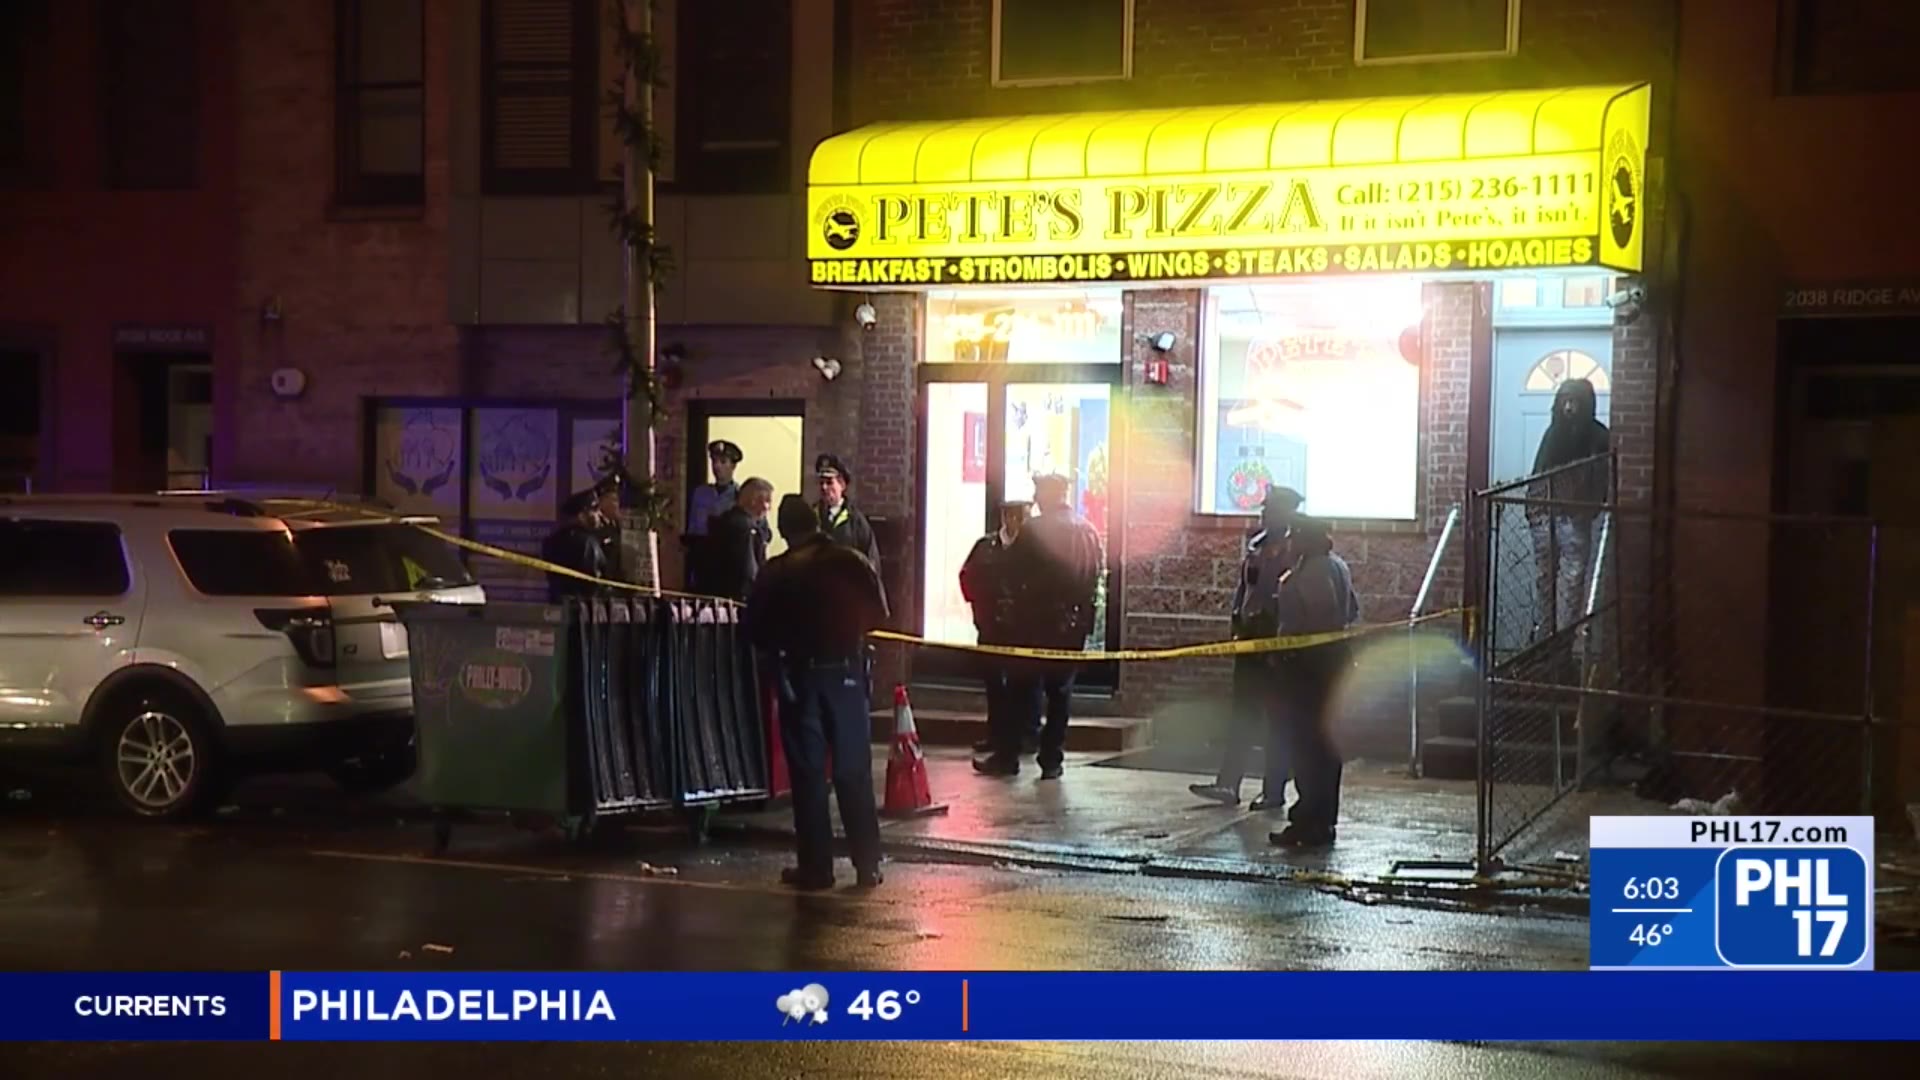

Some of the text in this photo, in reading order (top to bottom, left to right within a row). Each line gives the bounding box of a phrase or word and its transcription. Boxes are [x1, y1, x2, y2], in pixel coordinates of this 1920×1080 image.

[1337, 170, 1594, 205] Call: (215) 236-1111
[872, 188, 1083, 244] PETE'S
[1105, 179, 1328, 239] PIZZA
[1513, 206, 1527, 224] it
[1537, 202, 1588, 222] isn't.
[812, 238, 1592, 283] BREAKFAST STROMBOLIS WINGS STEAKS SALADS HOAGIES
[1785, 289, 1828, 307] 2038
[1833, 289, 1894, 305] RIDGE
